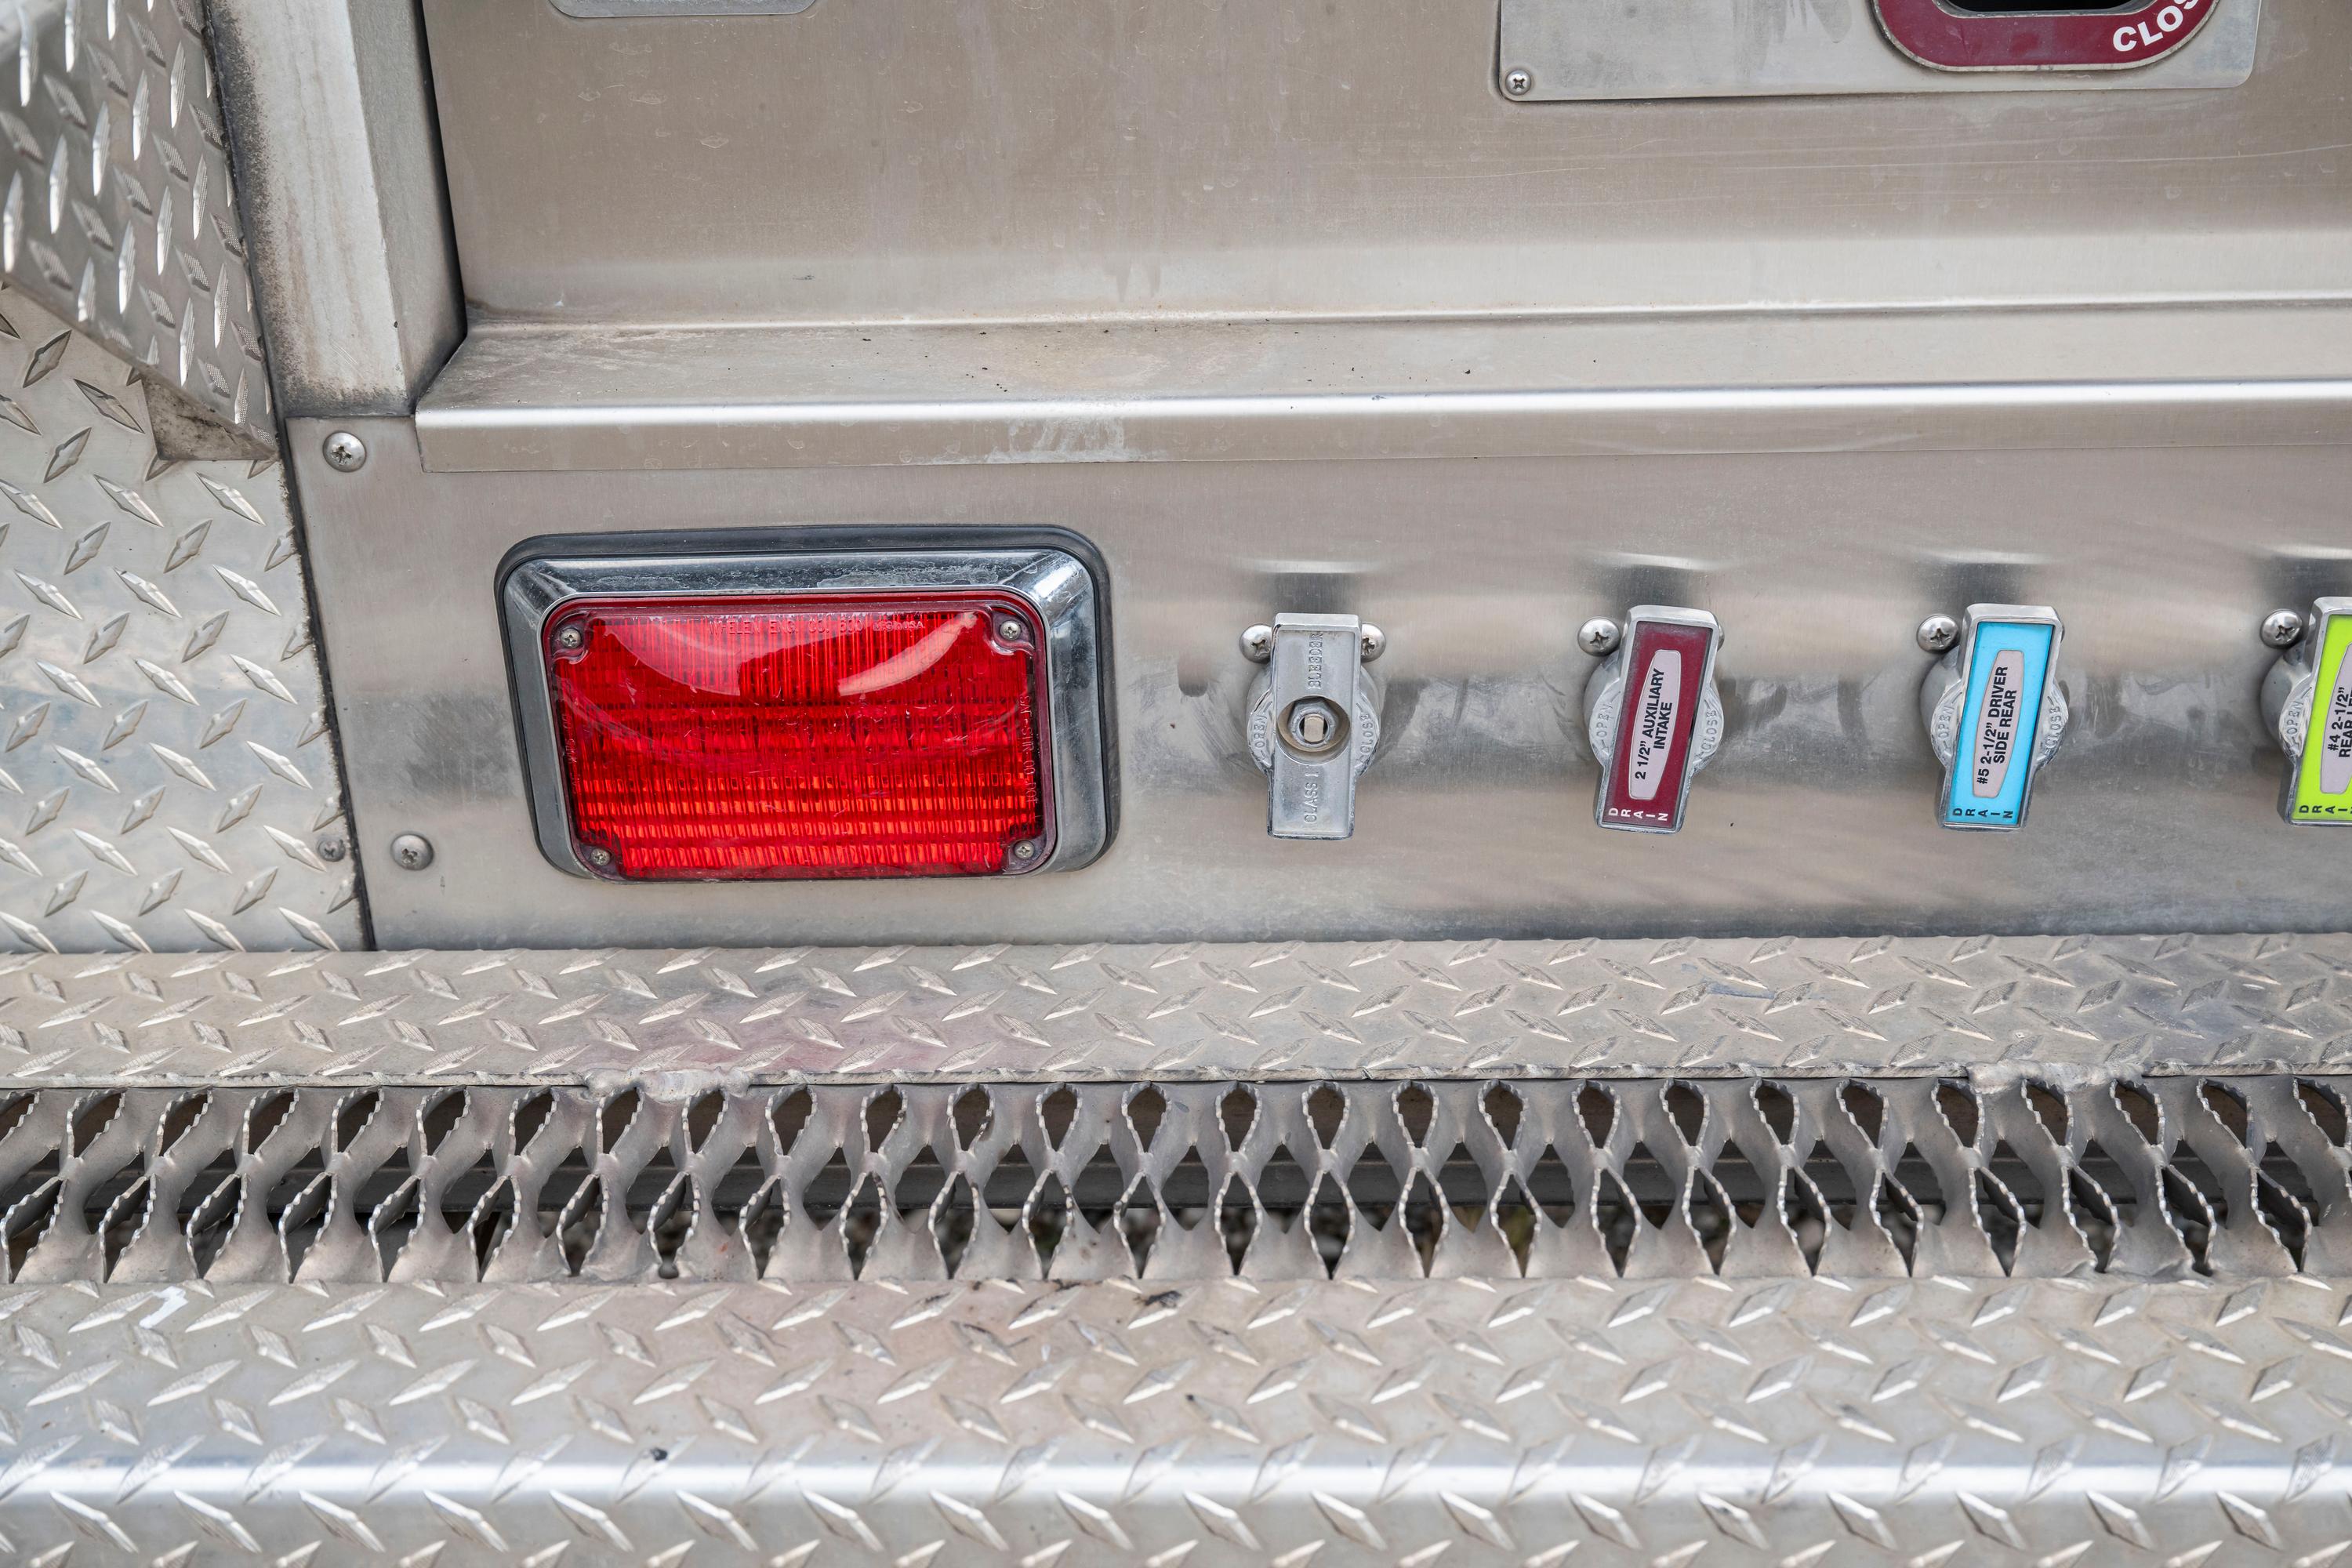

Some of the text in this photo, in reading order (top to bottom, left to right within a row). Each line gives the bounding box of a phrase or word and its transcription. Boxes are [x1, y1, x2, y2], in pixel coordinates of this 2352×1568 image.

[1308, 631, 1323, 690] BLEEDER
[1359, 713, 1372, 757] CLOSE
[1595, 702, 1613, 739] OPEN
[1635, 771, 1646, 780] 2
[1642, 668, 1664, 739] AUXILIARY
[1653, 702, 1673, 750] INTAKE
[1701, 709, 1717, 751] CLOSE
[1937, 705, 1955, 739] OPEN
[1976, 768, 1990, 785] #5
[1987, 666, 2009, 718] DRIVER
[1993, 689, 2017, 764] SIDE REAR
[2045, 705, 2062, 748] CLOSE
[2286, 699, 2305, 735] OPEN
[2327, 734, 2341, 752] #4
[1304, 782, 1319, 824] CLASS
[1608, 808, 1668, 822] DRAIN
[1952, 808, 2014, 819] DRAIN
[2299, 804, 2352, 815] DRAI
